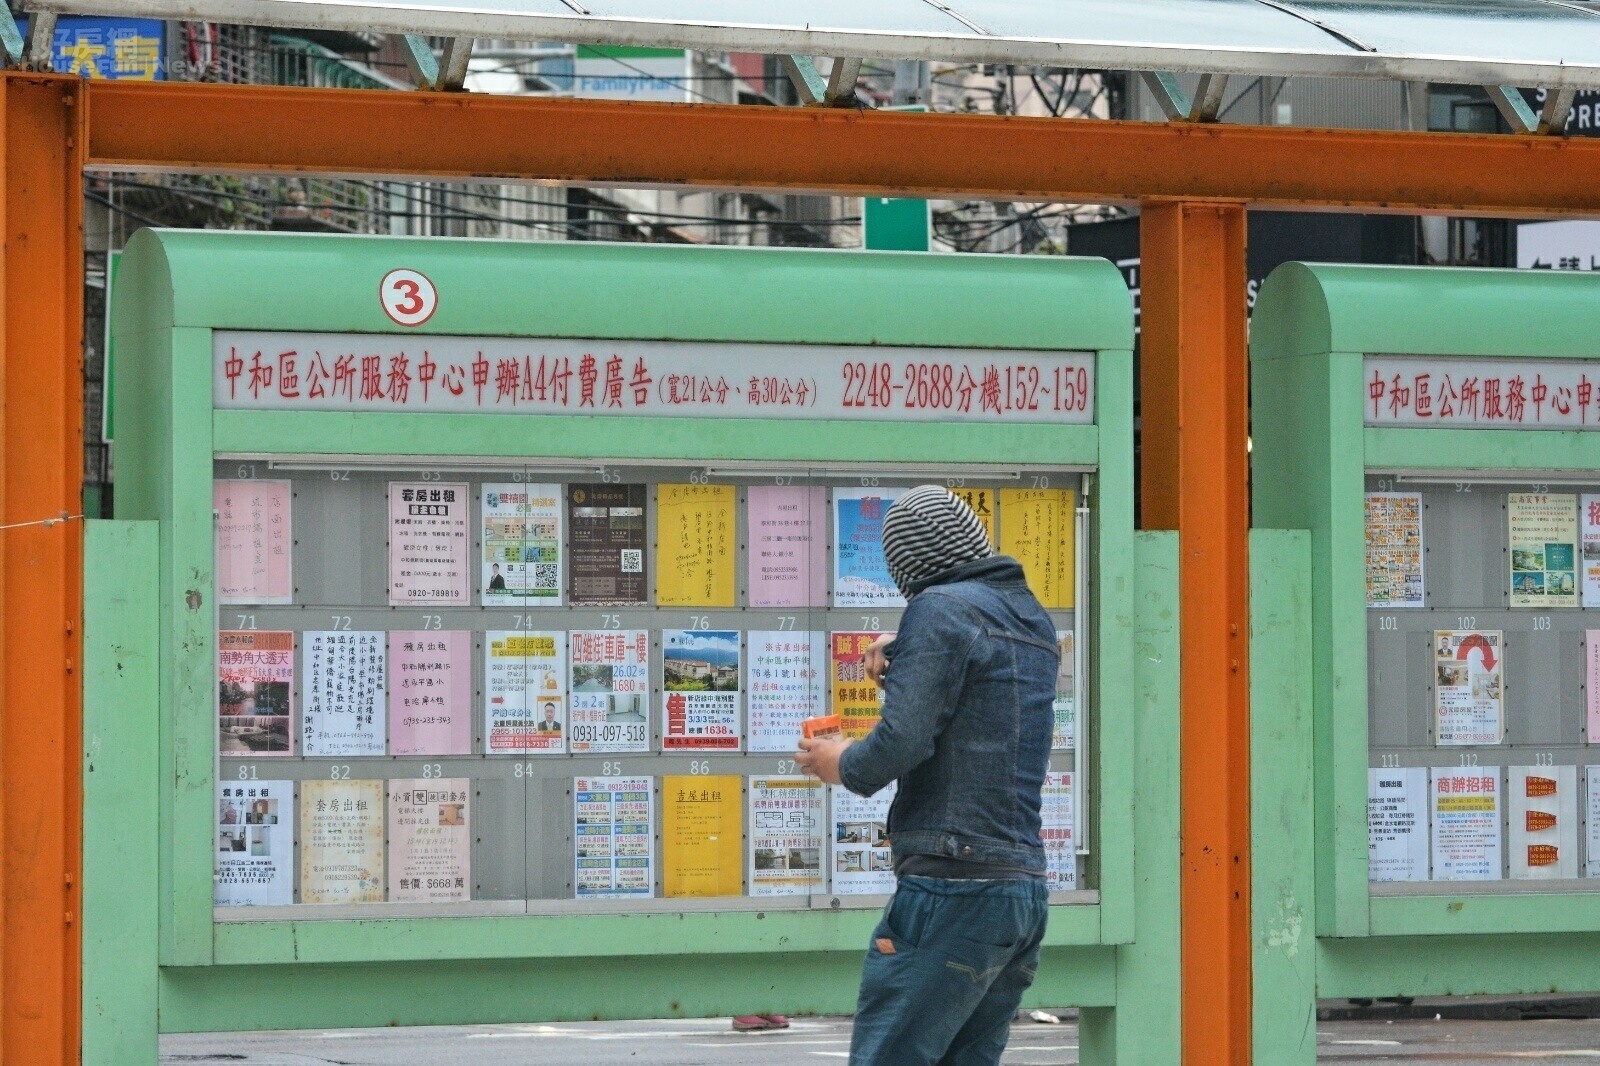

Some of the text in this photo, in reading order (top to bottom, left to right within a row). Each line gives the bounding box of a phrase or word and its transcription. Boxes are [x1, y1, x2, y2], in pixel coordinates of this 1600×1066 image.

[393, 279, 424, 315] 3
[1369, 370, 1600, 424] 中和區公所服務中心申
[238, 465, 257, 479] 61
[331, 470, 350, 481] 62
[422, 471, 441, 481] 63
[513, 471, 532, 482] 64
[602, 469, 621, 483] 65
[690, 470, 709, 484] 66
[776, 475, 793, 486] 67
[861, 476, 879, 487] 68
[947, 477, 965, 488] 69
[1030, 476, 1049, 489] 70
[1378, 479, 1395, 493] 91
[1455, 482, 1472, 493] 92
[1532, 482, 1549, 494] 93
[402, 489, 455, 502] 套房出租
[407, 589, 460, 598] 0920-789819
[237, 615, 257, 630] 71
[331, 616, 351, 631] 72
[422, 615, 442, 630] 73
[513, 615, 533, 629] 74
[602, 614, 620, 629] 75
[690, 616, 709, 630] 76
[777, 616, 796, 631] 77
[861, 616, 880, 631] 78
[1379, 616, 1398, 630] 101
[1458, 616, 1476, 631] 102
[1533, 616, 1551, 630] 103
[573, 633, 647, 663] 四維街車庫一樓
[219, 651, 288, 665] 南勢角大透天
[613, 665, 637, 677] 26.02
[613, 680, 635, 691] 1680
[573, 725, 646, 742] 0931-097-518
[705, 726, 727, 734] 1638
[777, 759, 796, 774] 87
[1381, 754, 1400, 768] 111
[1459, 753, 1478, 767] 112
[1535, 753, 1553, 767] 113
[238, 765, 258, 780] 81
[331, 765, 351, 780] 82
[422, 764, 442, 779] 83
[514, 762, 534, 778] 84
[602, 761, 621, 776] 85
[690, 760, 709, 775] 86
[1437, 777, 1495, 793] 商辦招租
[677, 789, 722, 801] 吉屋出租
[316, 798, 368, 812] 套房出租
[426, 879, 451, 889] $668
[454, 878, 465, 888] 萬
